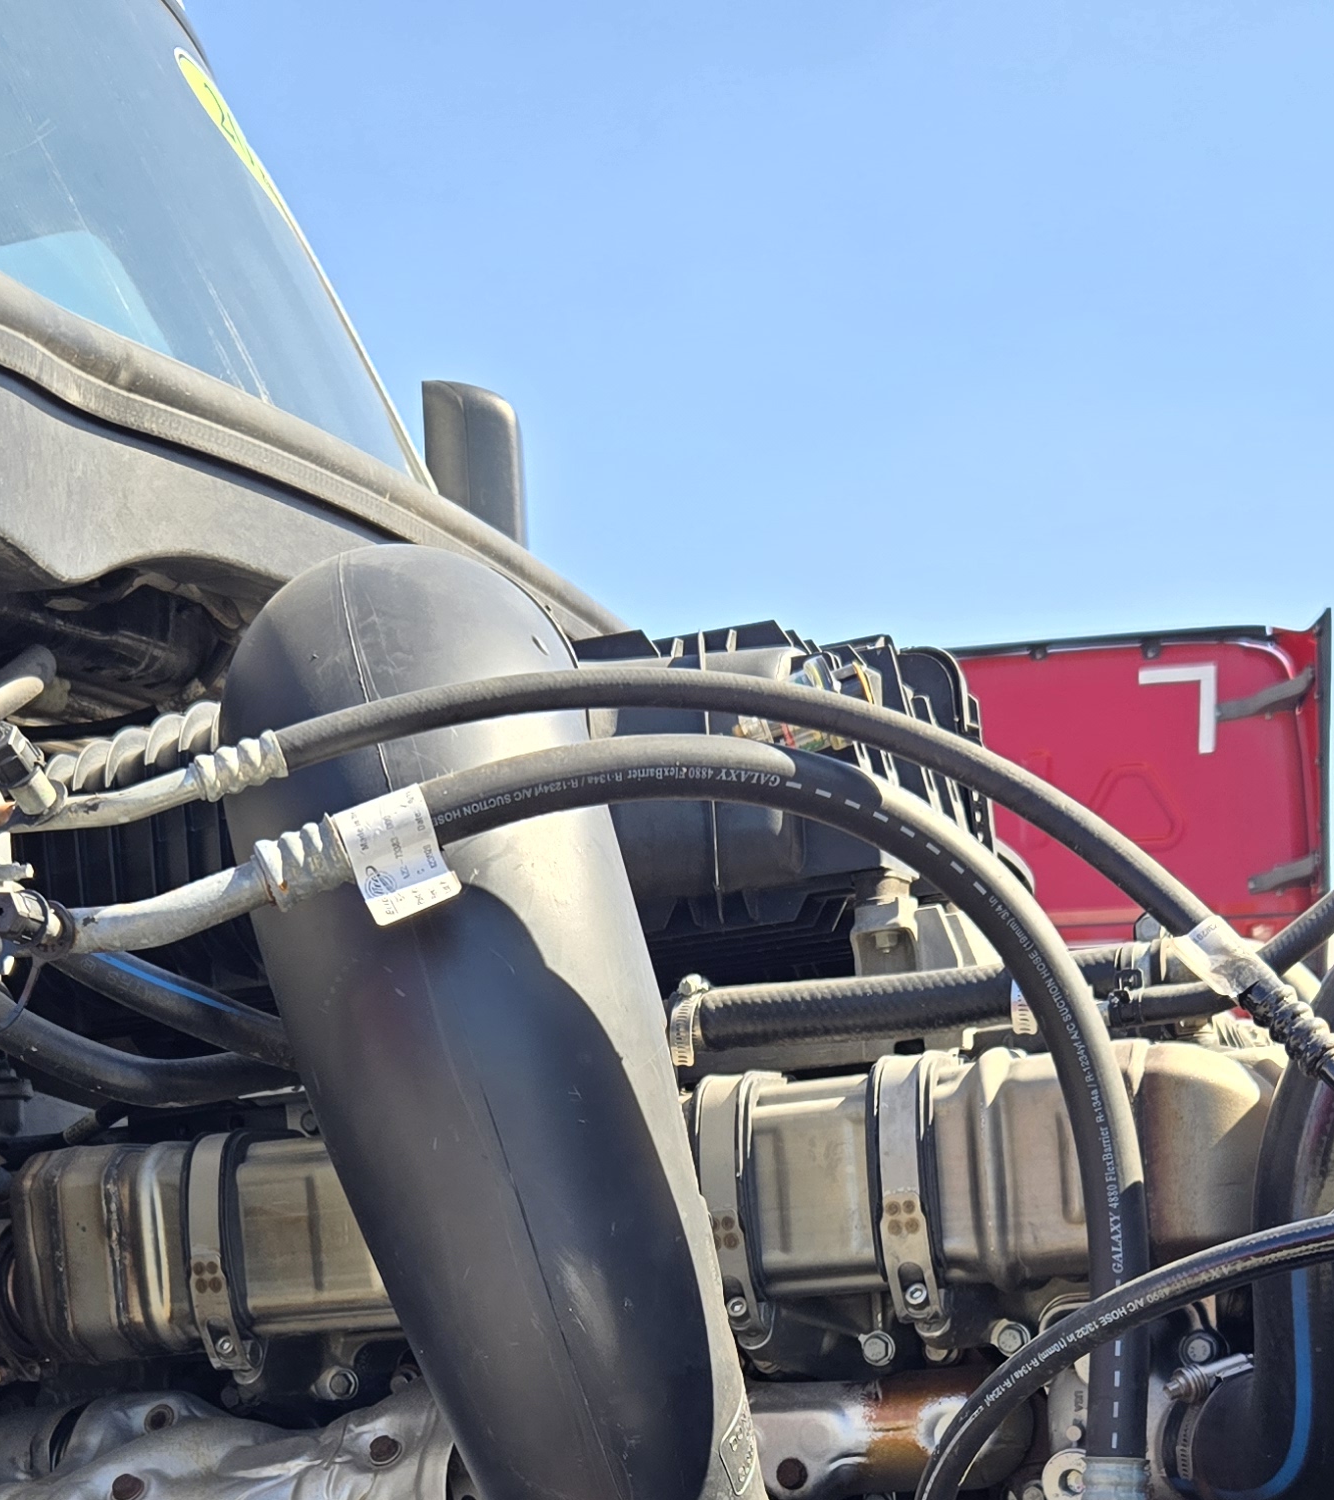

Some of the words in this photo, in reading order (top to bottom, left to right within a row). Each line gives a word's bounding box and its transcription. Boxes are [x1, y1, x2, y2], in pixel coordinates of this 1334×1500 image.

[588, 772, 623, 787] R-134a
[627, 767, 687, 782] FlexBarrier
[688, 766, 714, 780] 4880
[716, 767, 780, 787] GALAXY
[463, 793, 512, 816] SUCTION
[513, 787, 534, 804] A/C
[994, 901, 1008, 919] 3/4
[1007, 915, 1036, 950] (19mm)
[1028, 948, 1051, 981] HOSE
[1045, 976, 1072, 1022] SUCTION
[1066, 1020, 1080, 1041] A/C
[1091, 1088, 1105, 1124] R-134a
[1102, 1126, 1118, 1181] FlexBarrier
[1109, 1182, 1119, 1209] 4880
[1110, 1211, 1124, 1273] GALAXY
[1127, 1297, 1145, 1311] A/C
[1098, 1306, 1127, 1327] HOSE
[1074, 1320, 1099, 1339] 13/32
[1037, 1337, 1067, 1363] (10mm)
